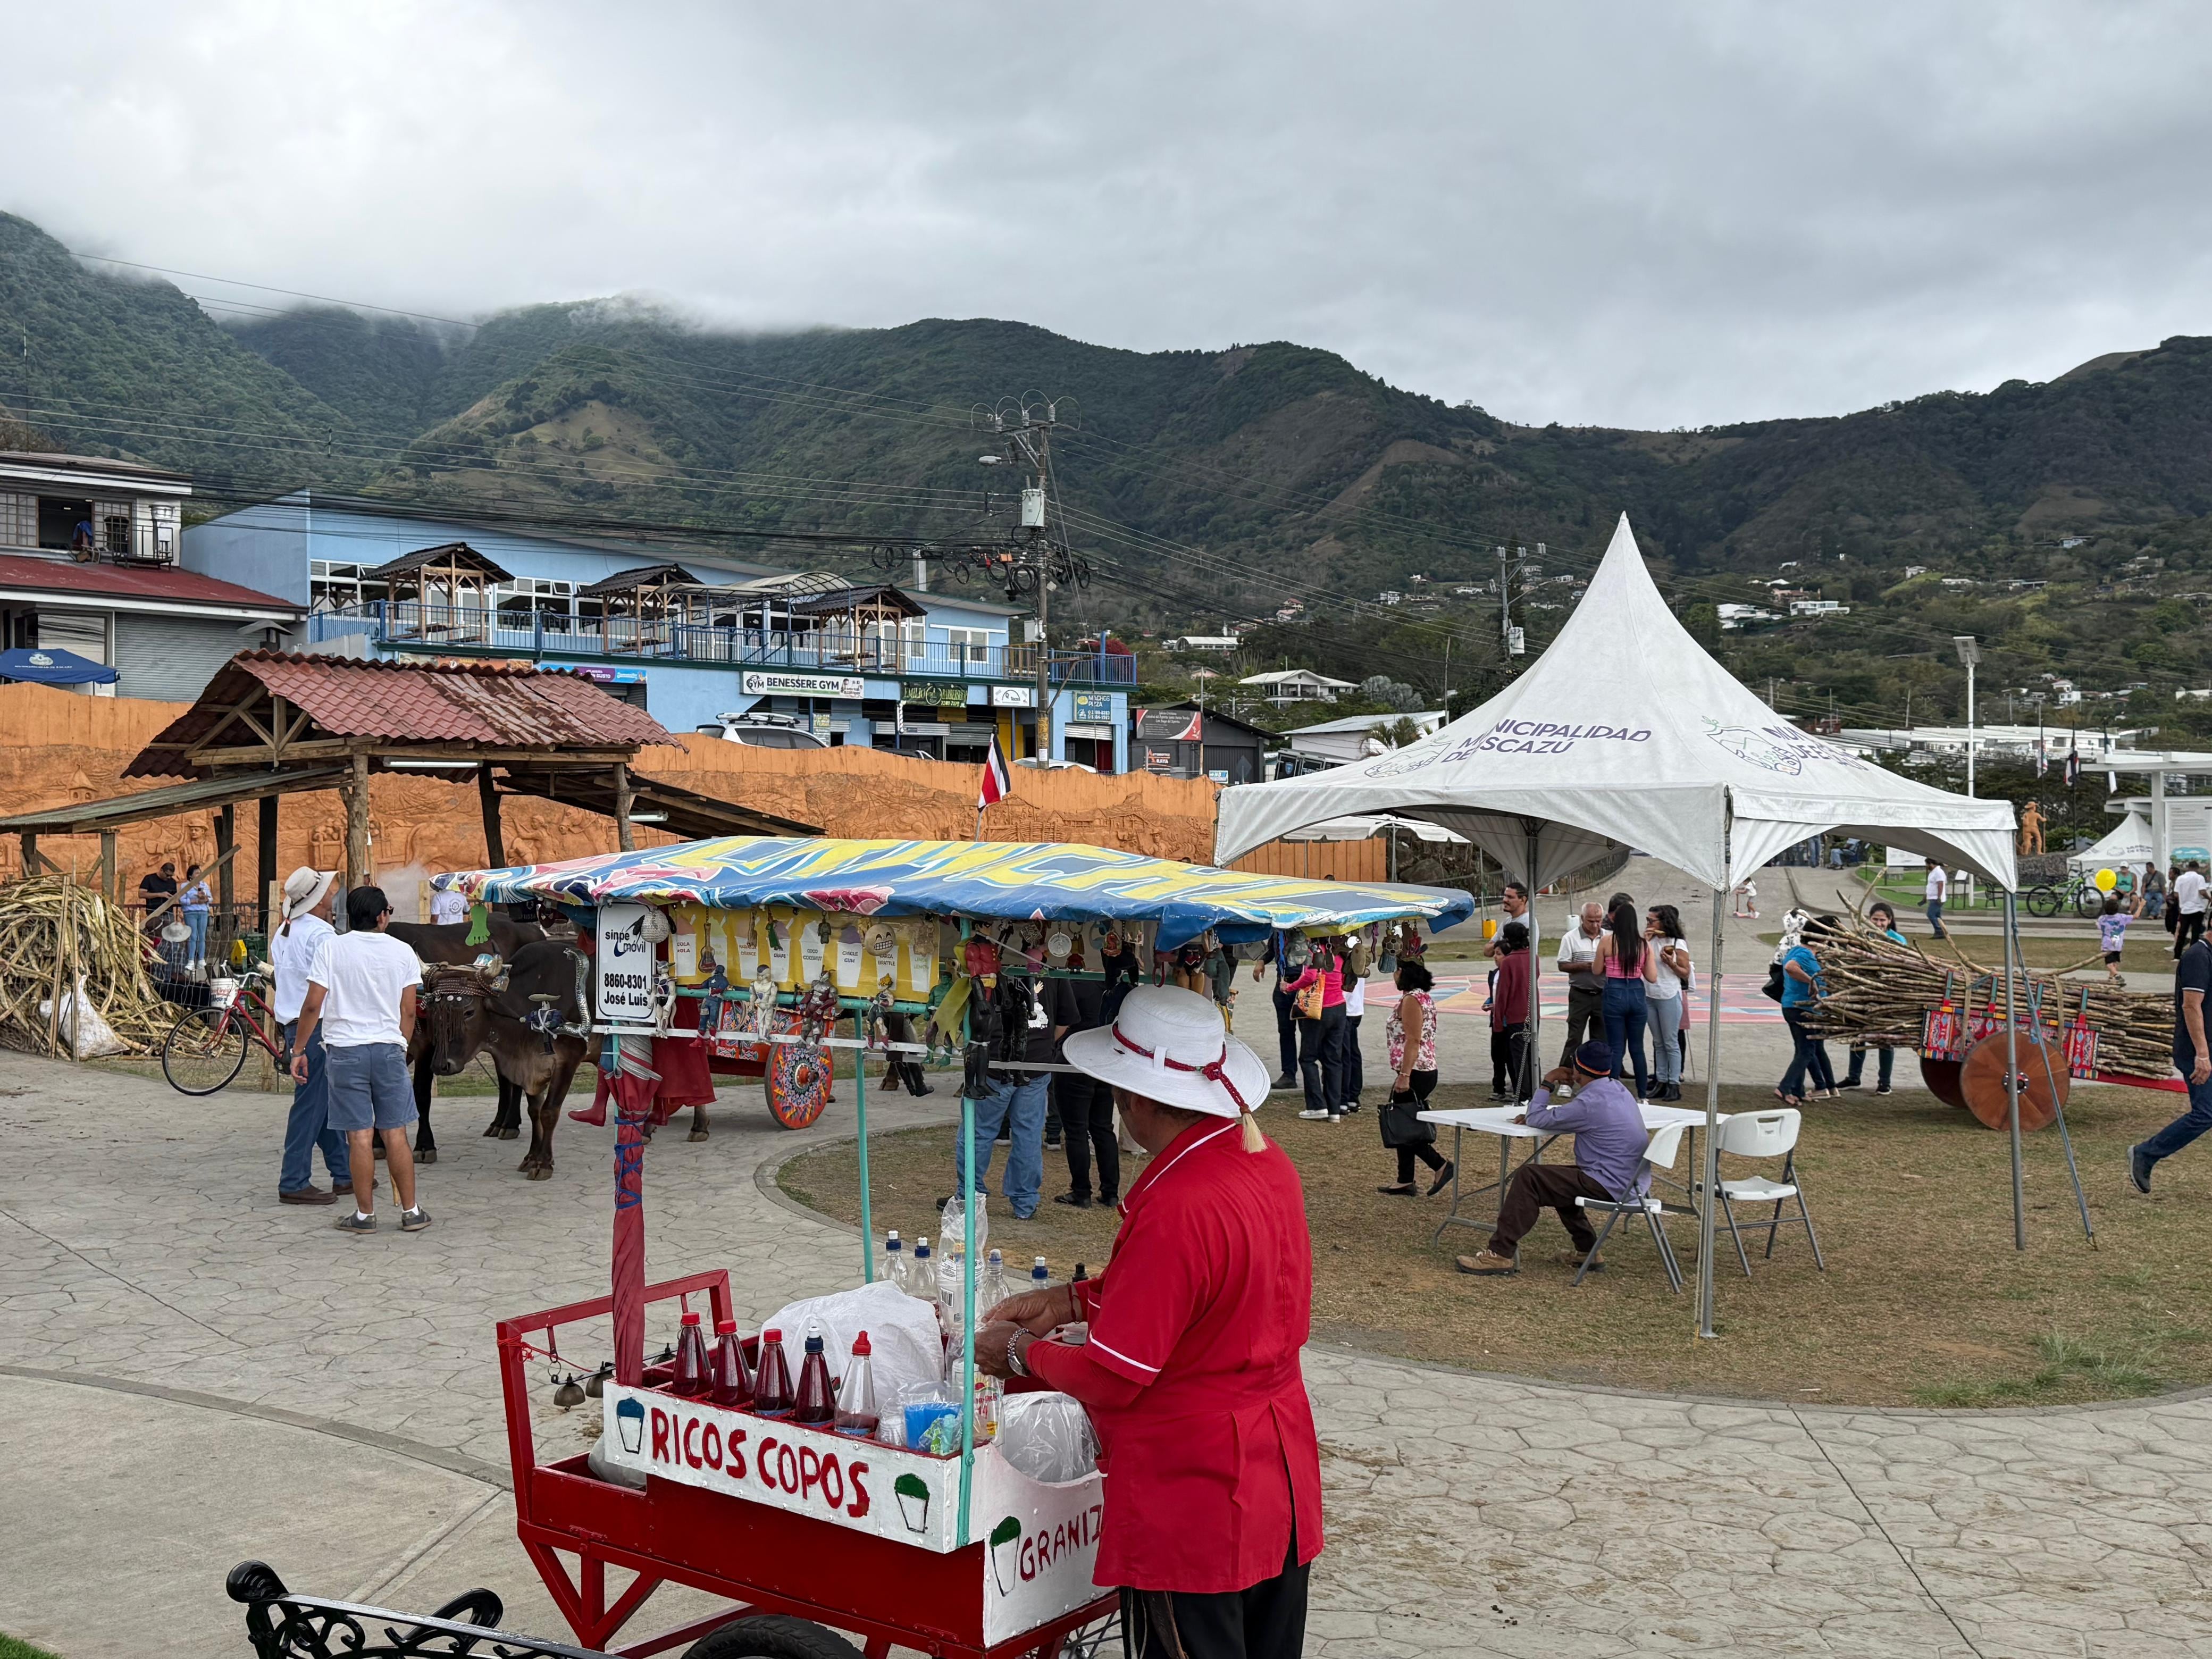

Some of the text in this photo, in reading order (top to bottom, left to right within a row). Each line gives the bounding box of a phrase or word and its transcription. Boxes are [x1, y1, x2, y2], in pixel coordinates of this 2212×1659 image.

[767, 677, 839, 690] BENESSERE GYM
[904, 687, 925, 698] EMILIO
[605, 929, 630, 943] sinpe
[623, 940, 646, 953] móvil
[604, 973, 647, 990] 8860-8301
[604, 991, 648, 1006] José Luis
[651, 1407, 870, 1518] RICOS COPOS
